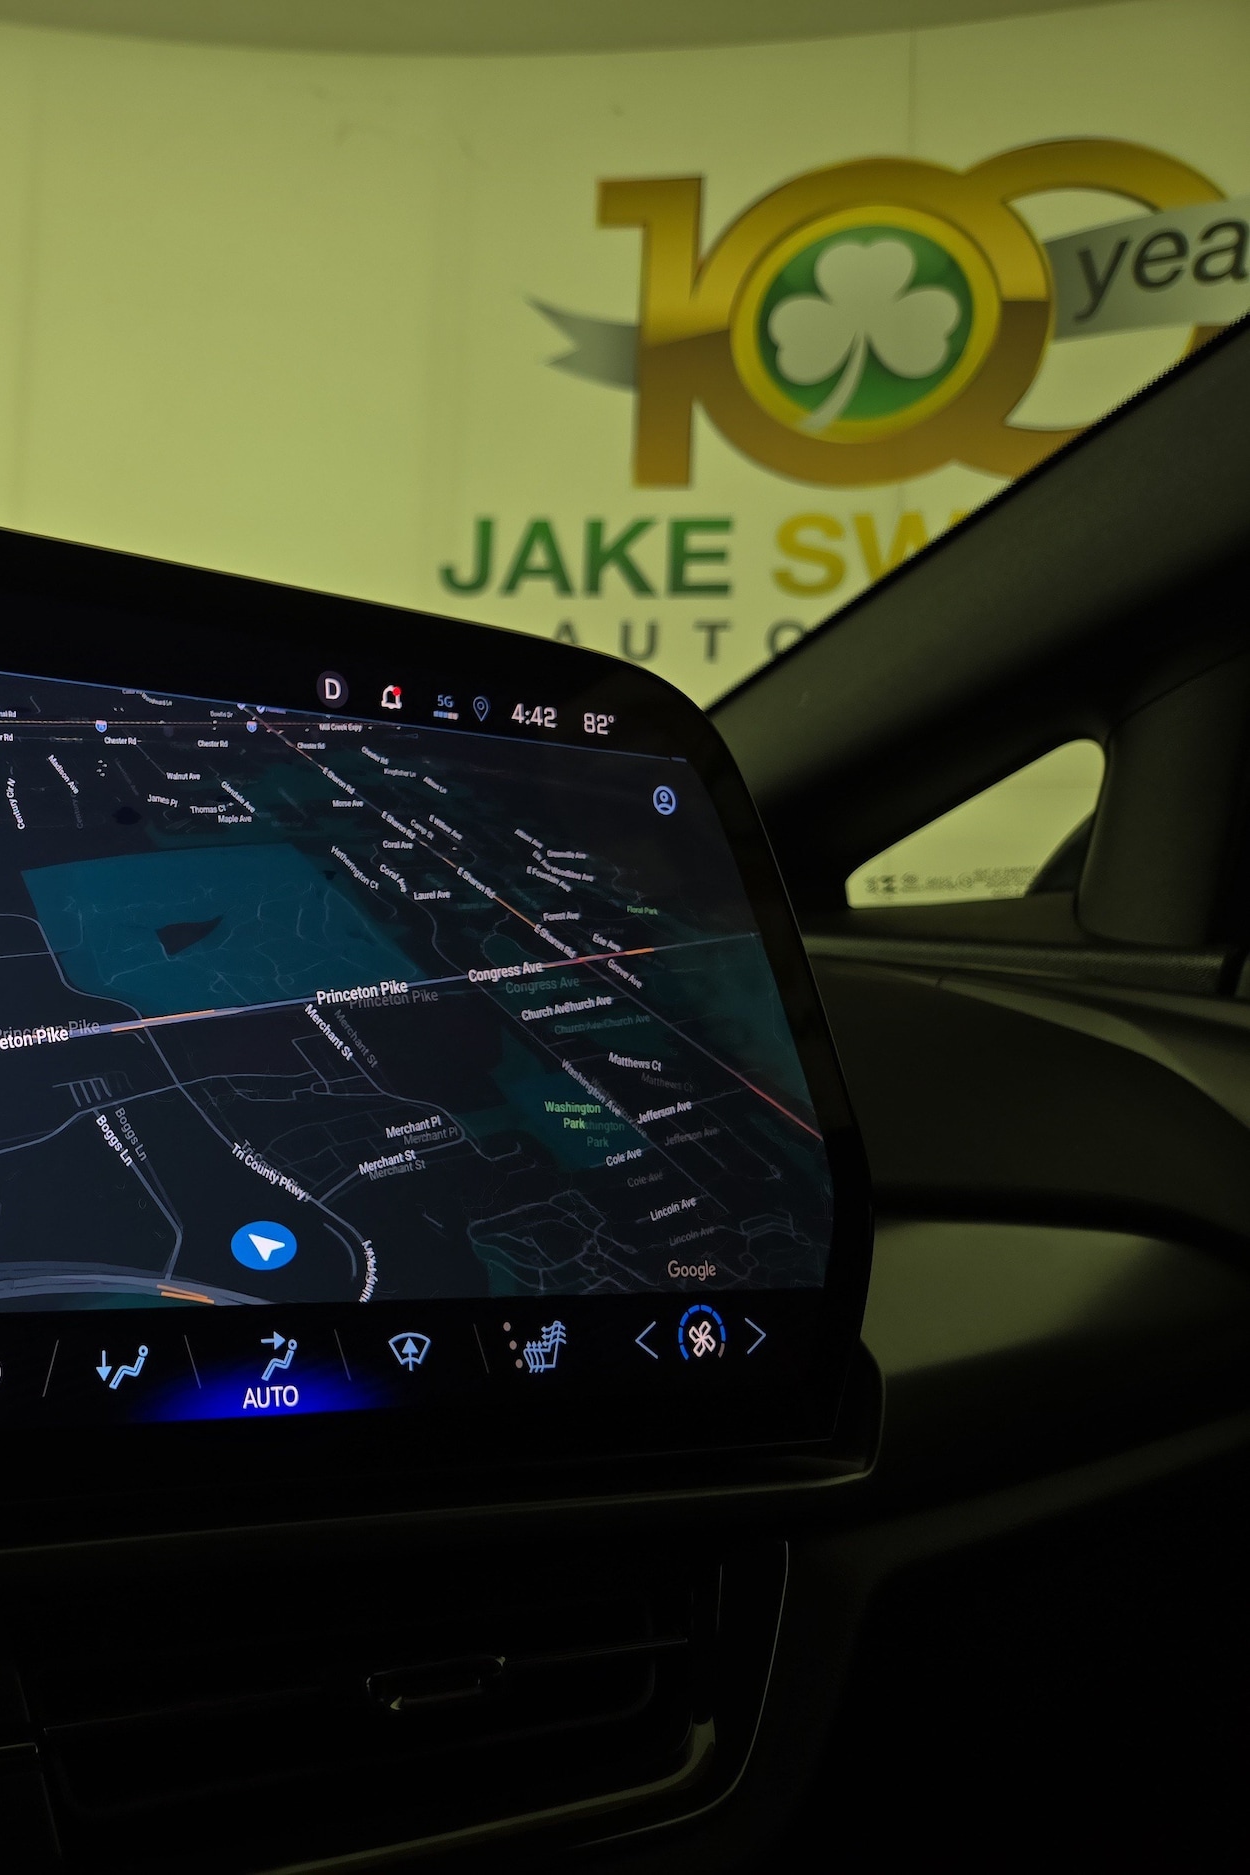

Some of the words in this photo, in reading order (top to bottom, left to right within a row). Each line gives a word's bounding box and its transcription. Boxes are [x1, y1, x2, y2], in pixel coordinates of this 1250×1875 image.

[439, 514, 734, 599] JAKE
[324, 677, 342, 700] D
[437, 694, 454, 708] 5G
[8, 710, 17, 718] Rd
[511, 703, 558, 728] 4:42
[4, 733, 14, 742] Rd
[104, 736, 127, 745] Chester
[128, 737, 137, 745] Rd
[197, 740, 219, 748] Chester
[220, 740, 228, 748] Rd
[7, 778, 16, 786] N
[48, 754, 70, 787] Madison
[67, 782, 79, 794] Ave
[166, 772, 188, 780] Walnut
[189, 772, 201, 780] Ave
[6, 786, 15, 798] Cir
[220, 780, 245, 805] Glendale
[243, 801, 256, 813] Ave
[9, 799, 25, 830] Century
[190, 806, 216, 814] Thomas
[218, 814, 238, 824] Maple
[239, 815, 252, 823] Ave
[386, 815, 408, 835] Sharon
[406, 829, 416, 840] Rd
[382, 840, 399, 849] Coral
[400, 840, 414, 849] Ave
[331, 846, 370, 887] Hetherington
[369, 879, 380, 890] Ct
[379, 864, 400, 882] Coral
[413, 891, 436, 900] Laurel
[437, 890, 451, 899] Ave
[461, 870, 486, 893] Sharon
[484, 886, 496, 899] Rd
[543, 912, 566, 922] Forest
[566, 911, 580, 920] Ave
[644, 906, 659, 916] Park
[539, 928, 566, 953] Sharon
[563, 945, 578, 959] Rd
[606, 940, 621, 952] Ave
[468, 964, 522, 983] Congress
[522, 961, 543, 974] Ave
[607, 958, 630, 980] Grove
[627, 974, 643, 990] Ave
[316, 984, 378, 1005] Princeton
[379, 979, 409, 997] Pike
[35, 1026, 69, 1046] Pike
[304, 1003, 343, 1050] Merchant
[340, 1045, 353, 1061] St
[608, 1052, 650, 1070] Matthews
[651, 1059, 662, 1072] Ct
[561, 1058, 606, 1104] Washington
[605, 1099, 622, 1118] Ave
[544, 1101, 601, 1116] Washington
[637, 1104, 676, 1125] Jefferson
[676, 1100, 692, 1112] Ave
[114, 1107, 139, 1148] Boggs
[134, 1144, 147, 1161] Ln
[385, 1118, 430, 1139] Merchant
[431, 1115, 442, 1128] Pl
[563, 1117, 586, 1130] Park
[95, 1115, 123, 1152] Boggs
[119, 1149, 133, 1167] Ln
[231, 1142, 244, 1160] Tri
[244, 1154, 280, 1185] County
[359, 1154, 404, 1175] Merchant
[405, 1150, 416, 1161] St
[606, 1152, 626, 1167] Cole
[626, 1147, 642, 1161] Ave
[650, 1201, 680, 1221] Lincoln
[681, 1196, 697, 1210] Ave
[667, 1259, 717, 1281] Google
[241, 1385, 300, 1410] AUTO
